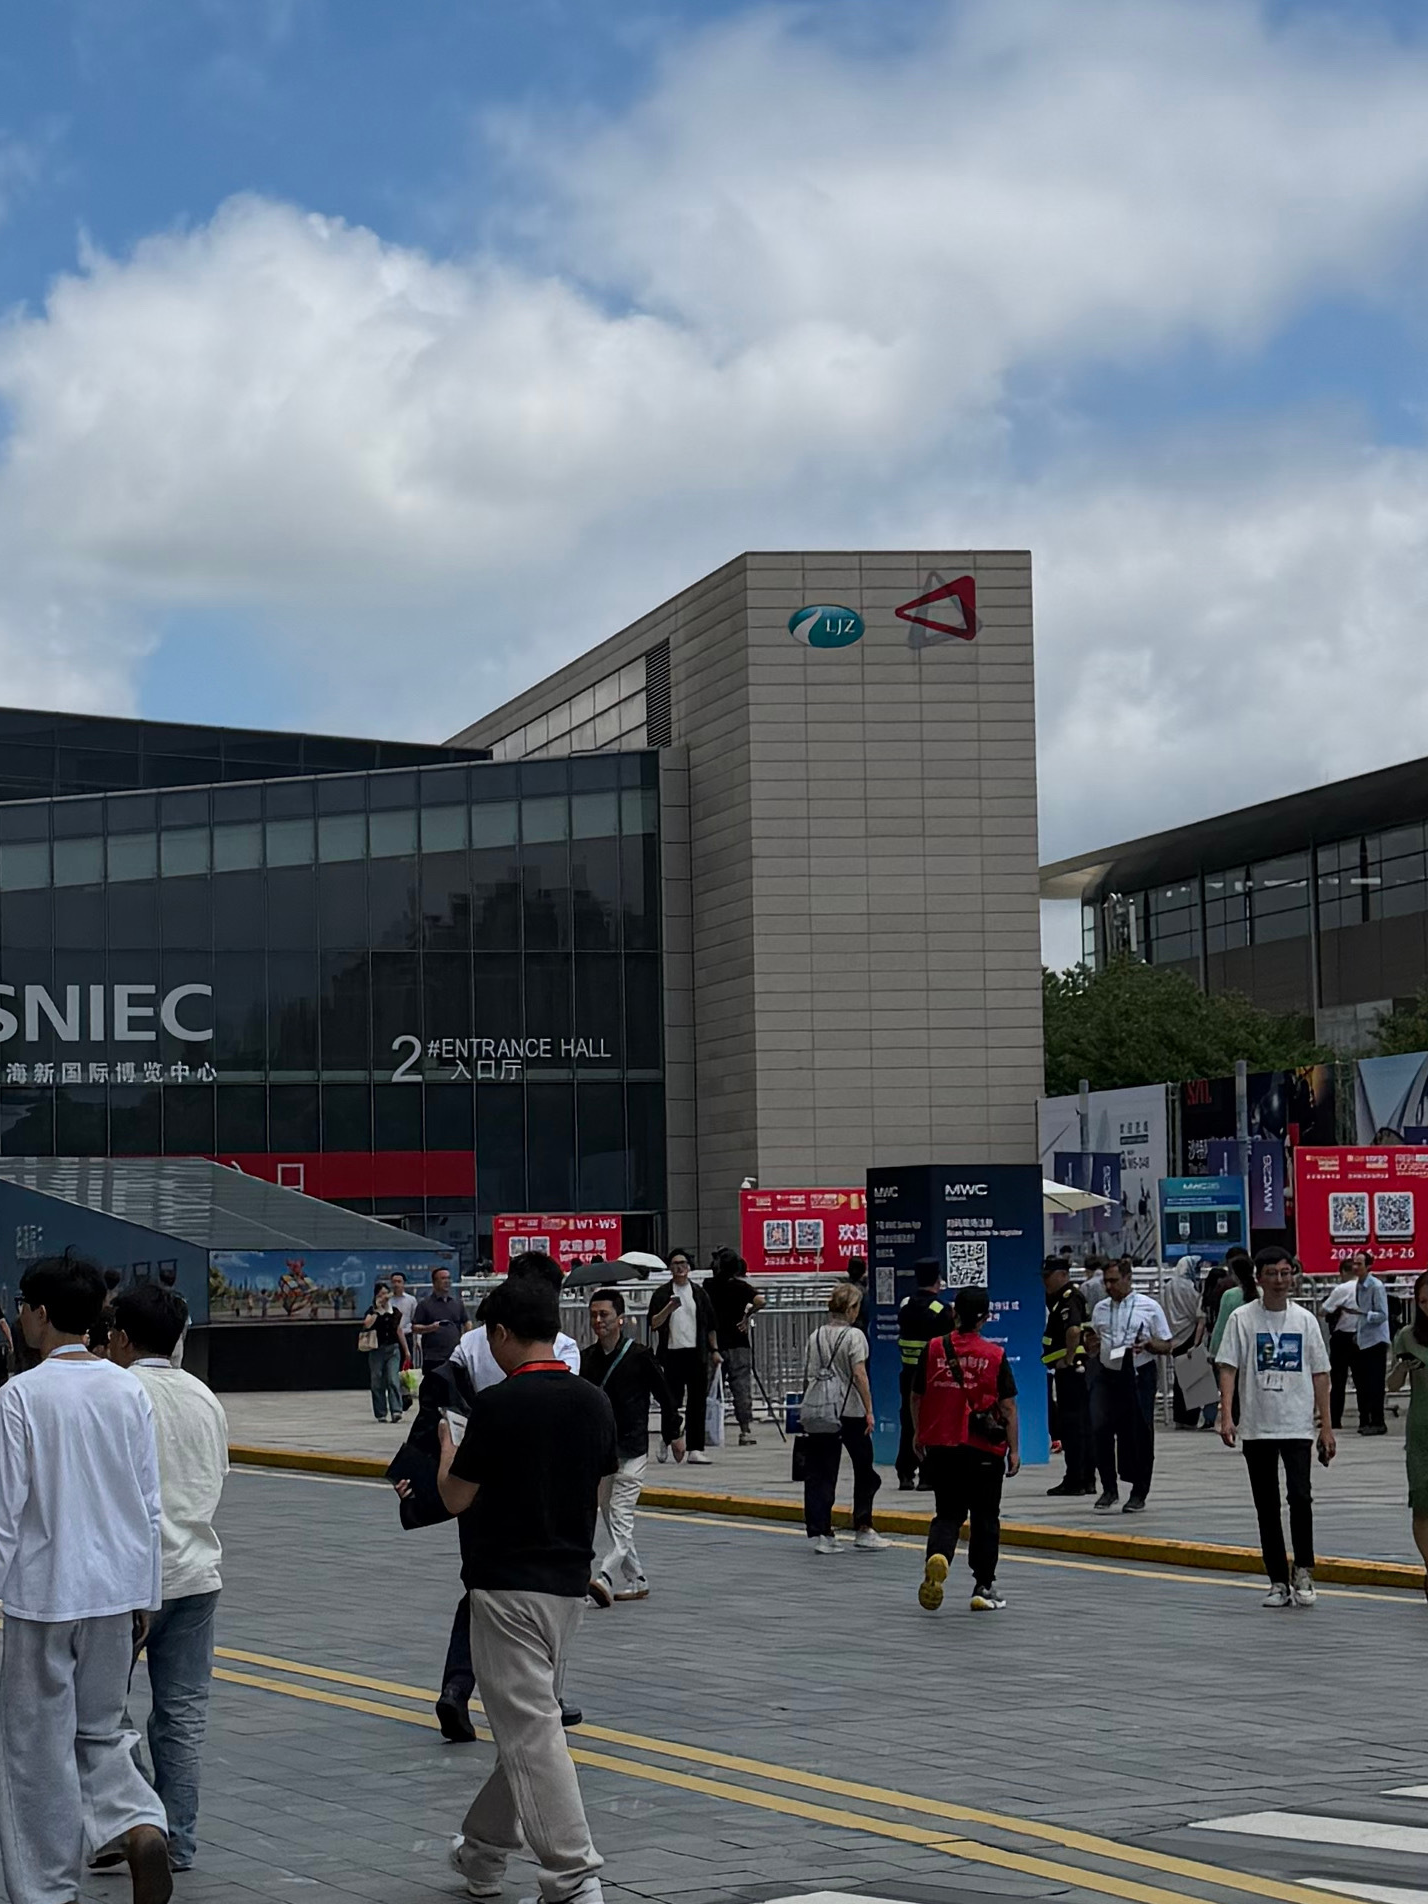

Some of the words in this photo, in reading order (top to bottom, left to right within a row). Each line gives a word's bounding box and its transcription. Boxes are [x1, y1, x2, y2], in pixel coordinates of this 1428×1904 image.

[826, 618, 856, 636] LJZ
[427, 1038, 552, 1058] #ENTRANCE
[561, 1038, 612, 1058] HALL
[391, 1034, 423, 1083] 2
[450, 1059, 523, 1080] 入口厅
[874, 1186, 899, 1198] MWC
[944, 1183, 989, 1196] MWC
